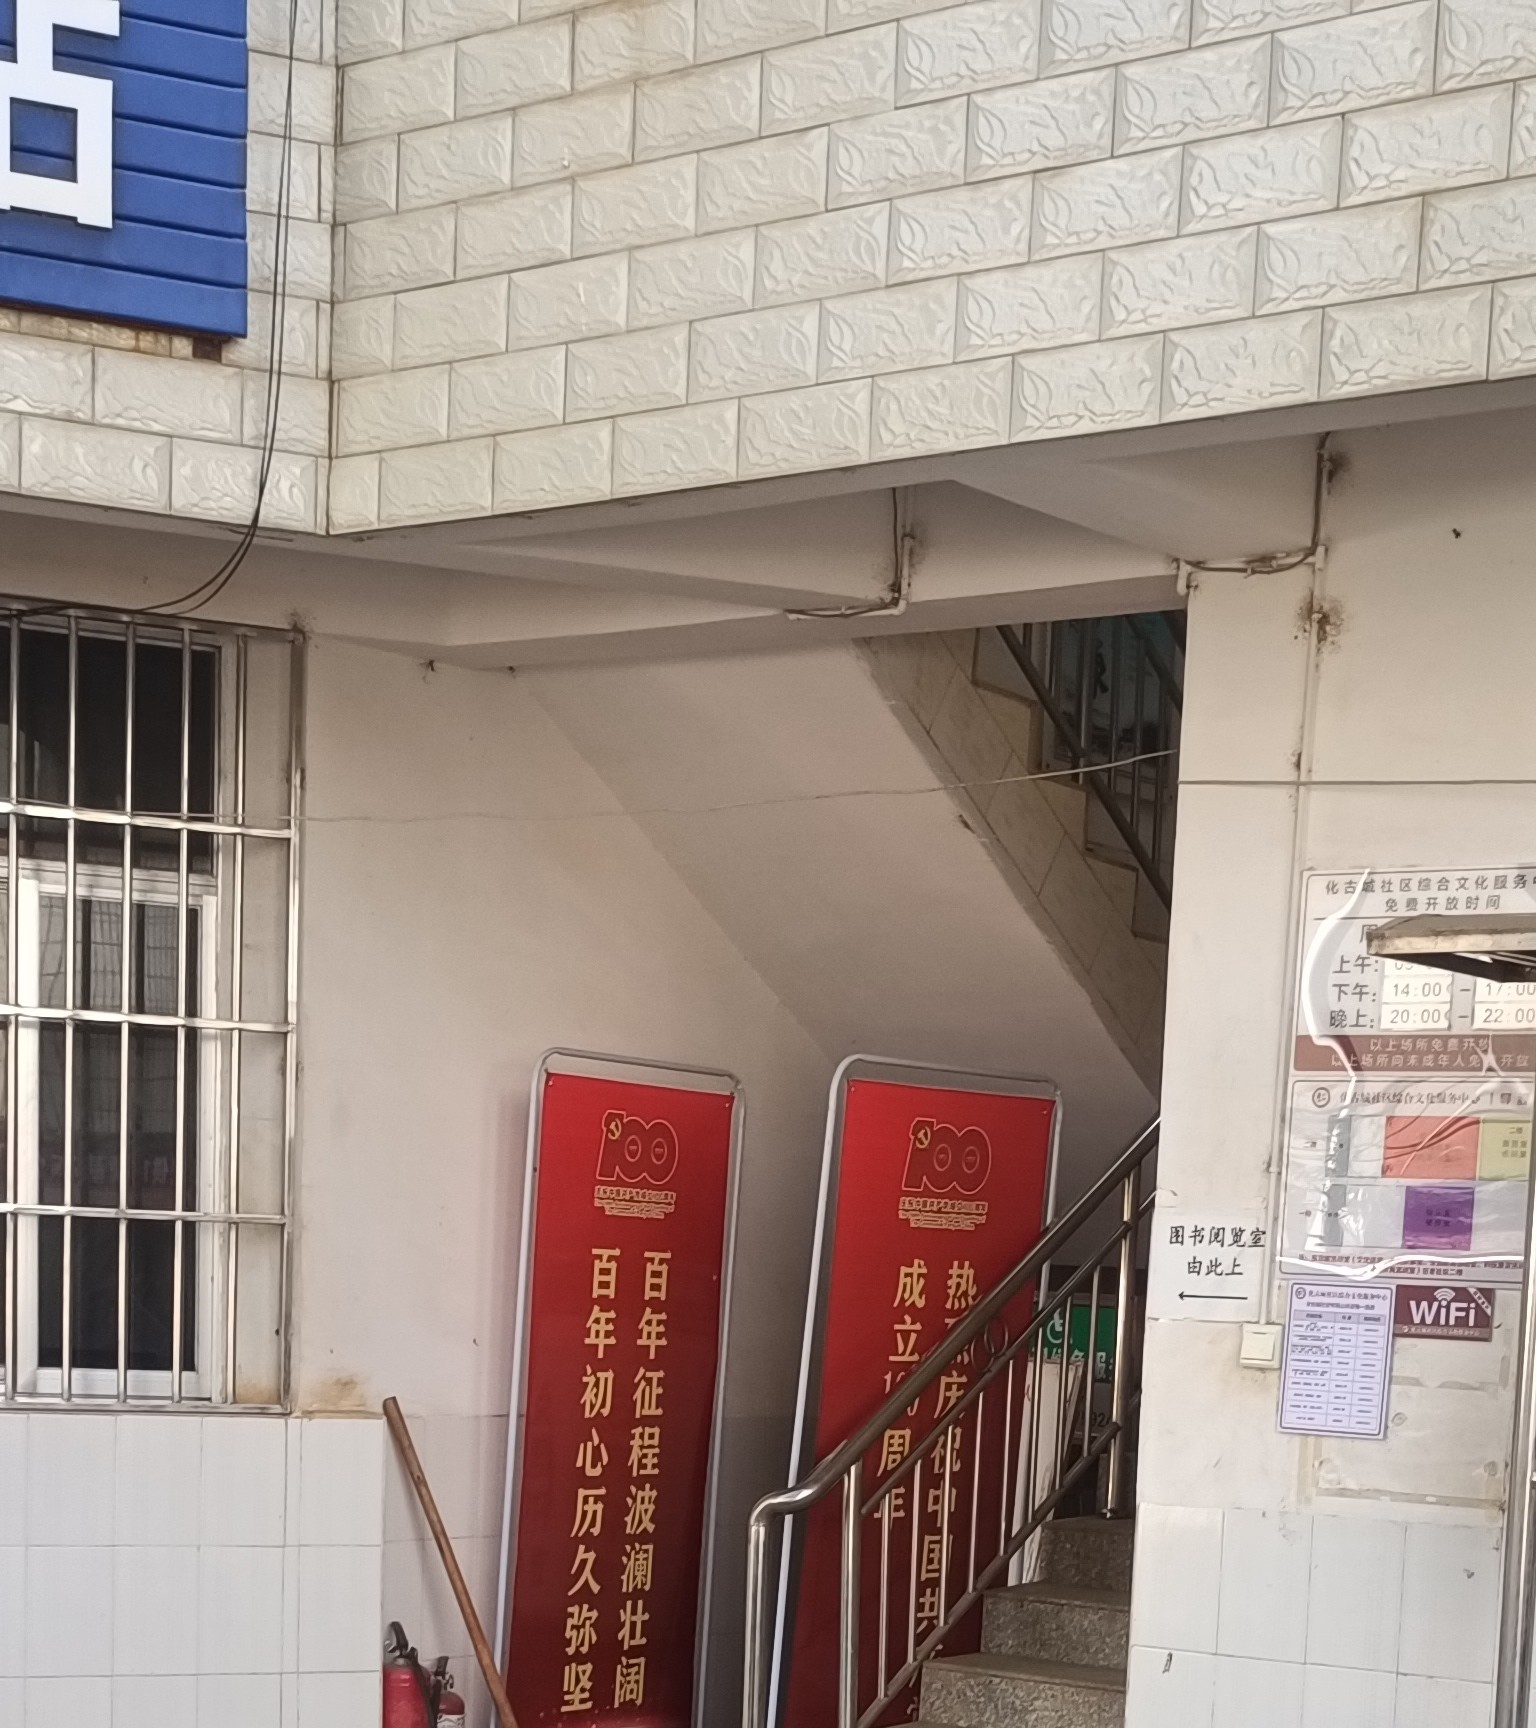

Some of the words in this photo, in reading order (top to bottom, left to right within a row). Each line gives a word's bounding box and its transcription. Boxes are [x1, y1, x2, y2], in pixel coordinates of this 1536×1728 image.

[1384, 894, 1500, 913] 免费开放时间
[1393, 982, 1442, 998] 14:00
[1390, 1009, 1442, 1024] 20:00
[1482, 1008, 1536, 1024] 22:00
[1169, 1224, 1266, 1249] 图书阅览室
[1187, 1257, 1244, 1277] 由此上
[1409, 1298, 1477, 1327] WiFi
[873, 1258, 928, 1530] 成立1周年
[560, 1247, 621, 1713] 百年初心历久弥坚
[614, 1250, 672, 1709] 百年征程波澜壮阔
